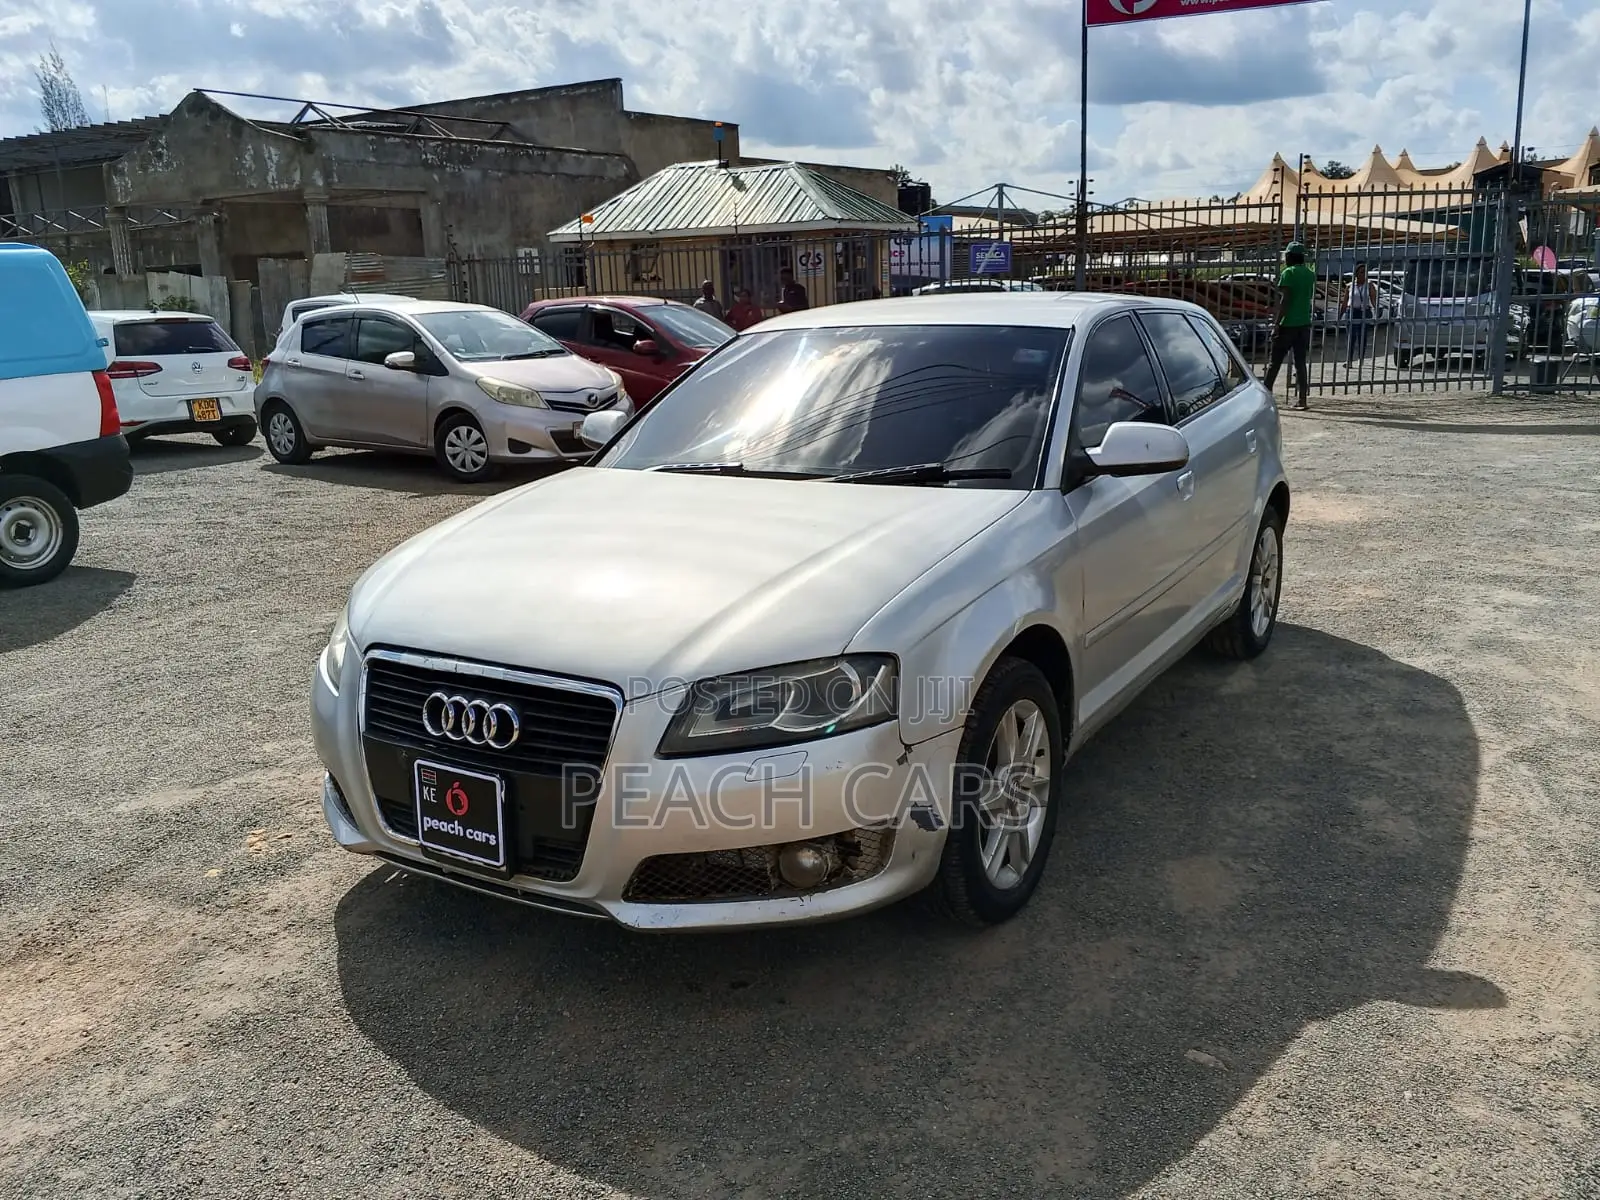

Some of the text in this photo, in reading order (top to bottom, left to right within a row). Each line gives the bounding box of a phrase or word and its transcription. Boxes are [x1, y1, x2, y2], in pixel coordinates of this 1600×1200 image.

[423, 785, 437, 803] KE
[423, 816, 497, 846] peach cars
